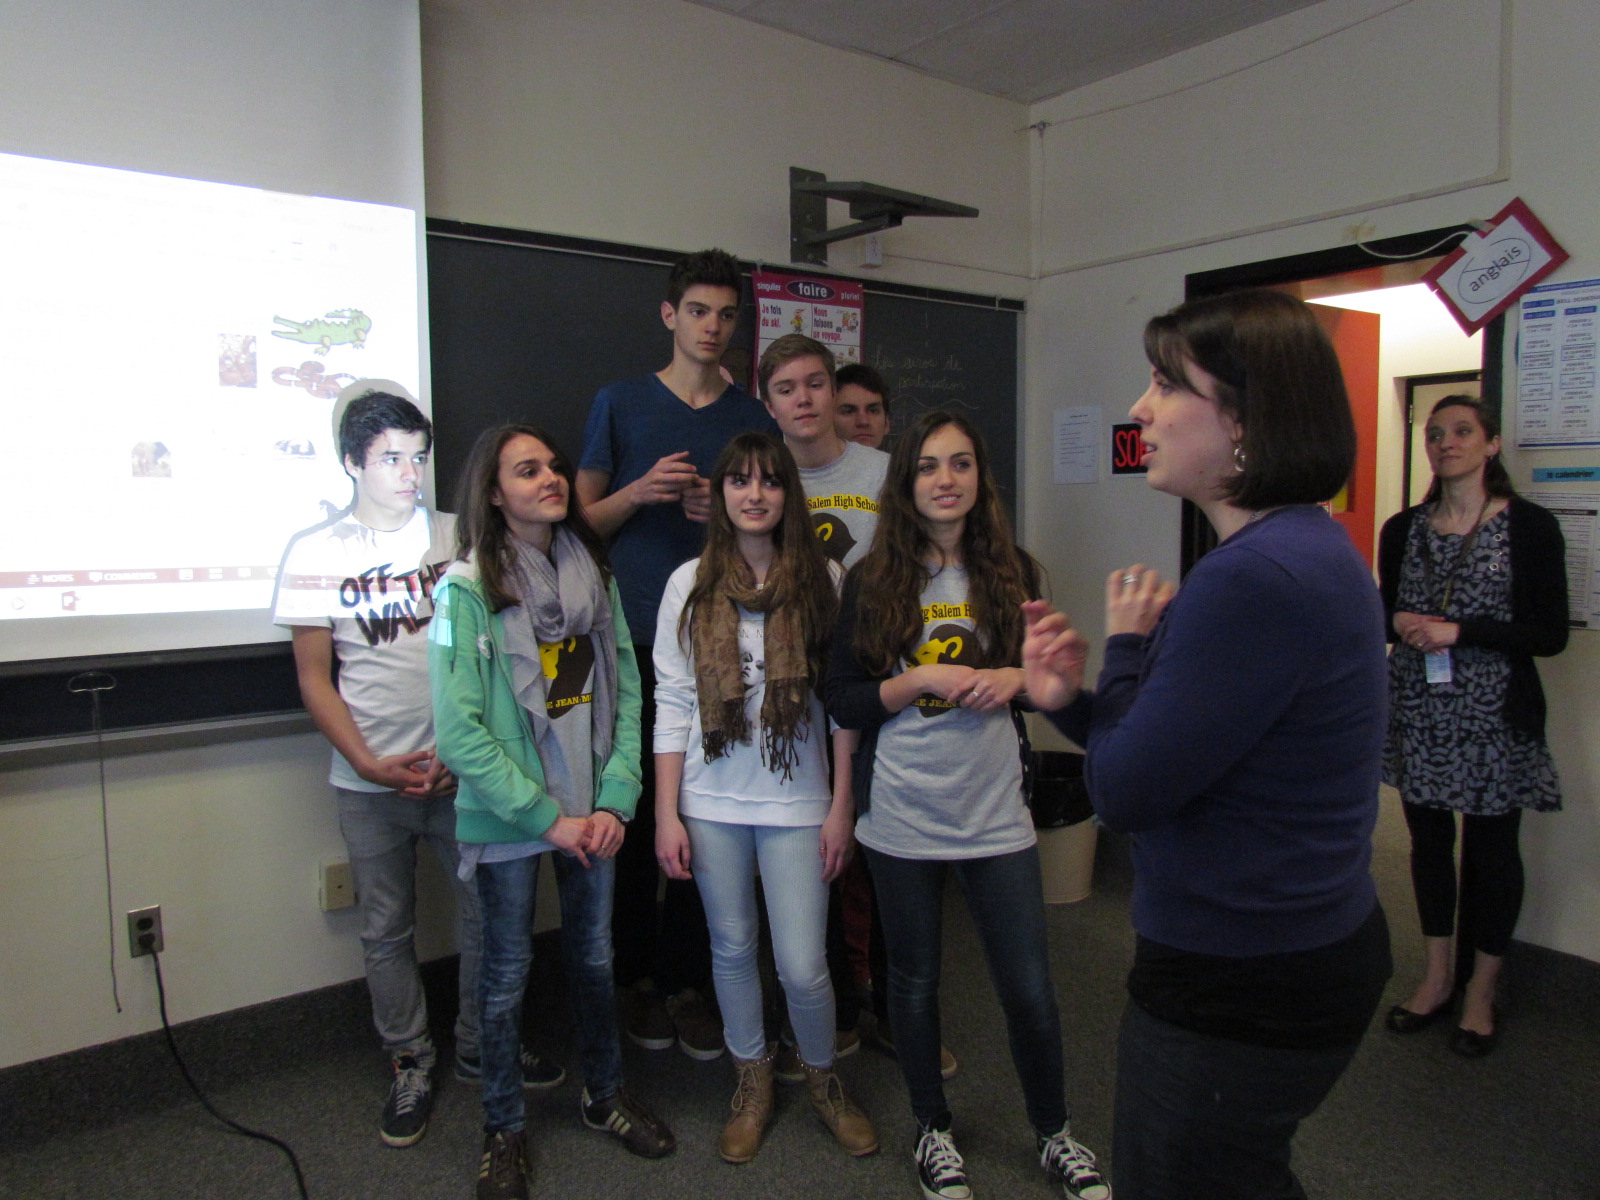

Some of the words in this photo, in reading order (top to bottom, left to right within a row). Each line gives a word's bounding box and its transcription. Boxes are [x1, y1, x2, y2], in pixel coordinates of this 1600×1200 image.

[1469, 246, 1521, 292] anglais
[757, 282, 781, 293] singulier
[798, 283, 828, 298] faire
[840, 292, 860, 301] pluriel
[762, 304, 770, 314] Je
[813, 306, 828, 317] Nous
[761, 317, 769, 327] du
[1555, 471, 1594, 479] calendrier
[807, 498, 832, 510] Salem
[834, 496, 854, 510] High
[340, 562, 394, 609] OFF
[932, 604, 962, 618] Salem
[555, 696, 579, 708] JEAN
